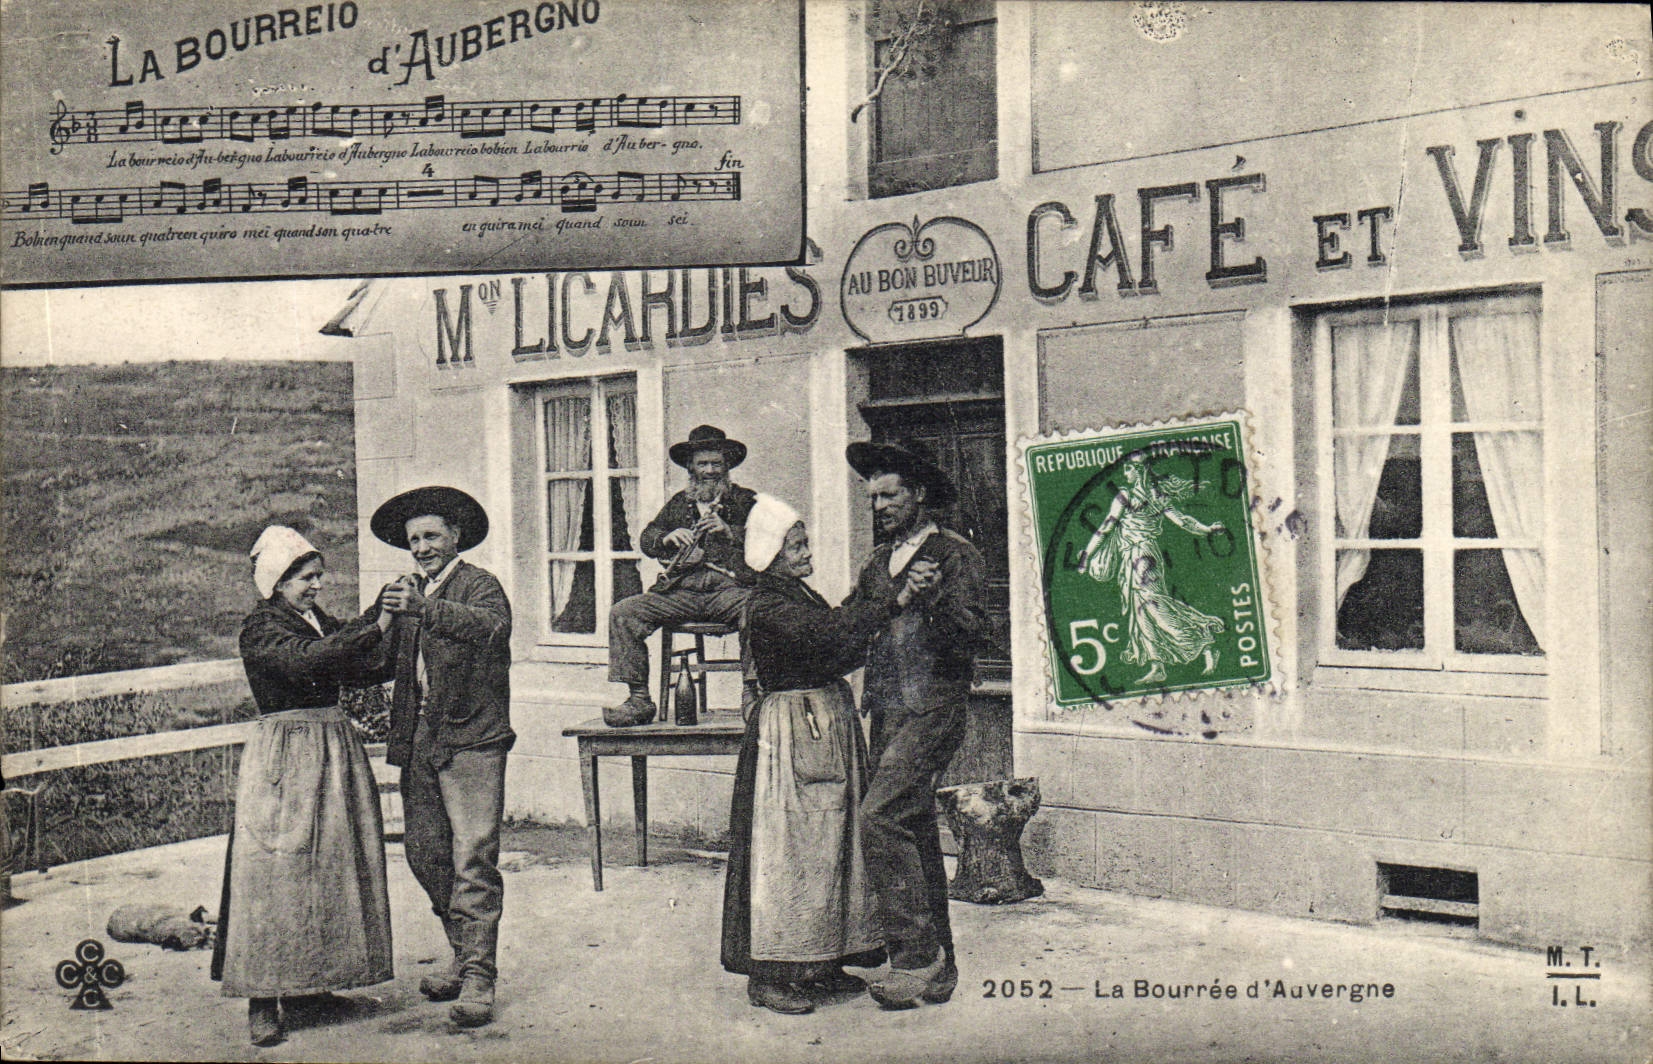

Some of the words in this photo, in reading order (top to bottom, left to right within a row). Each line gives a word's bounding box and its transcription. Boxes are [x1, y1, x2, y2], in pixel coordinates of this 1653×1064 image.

[1026, 154, 1269, 304] CAFÉ
[1313, 205, 1393, 271] ET
[848, 271, 873, 296] AU
[877, 266, 918, 293] BON
[923, 257, 997, 288] BUVEUR
[893, 300, 940, 322] 1899
[1230, 582, 1258, 668] POSTES
